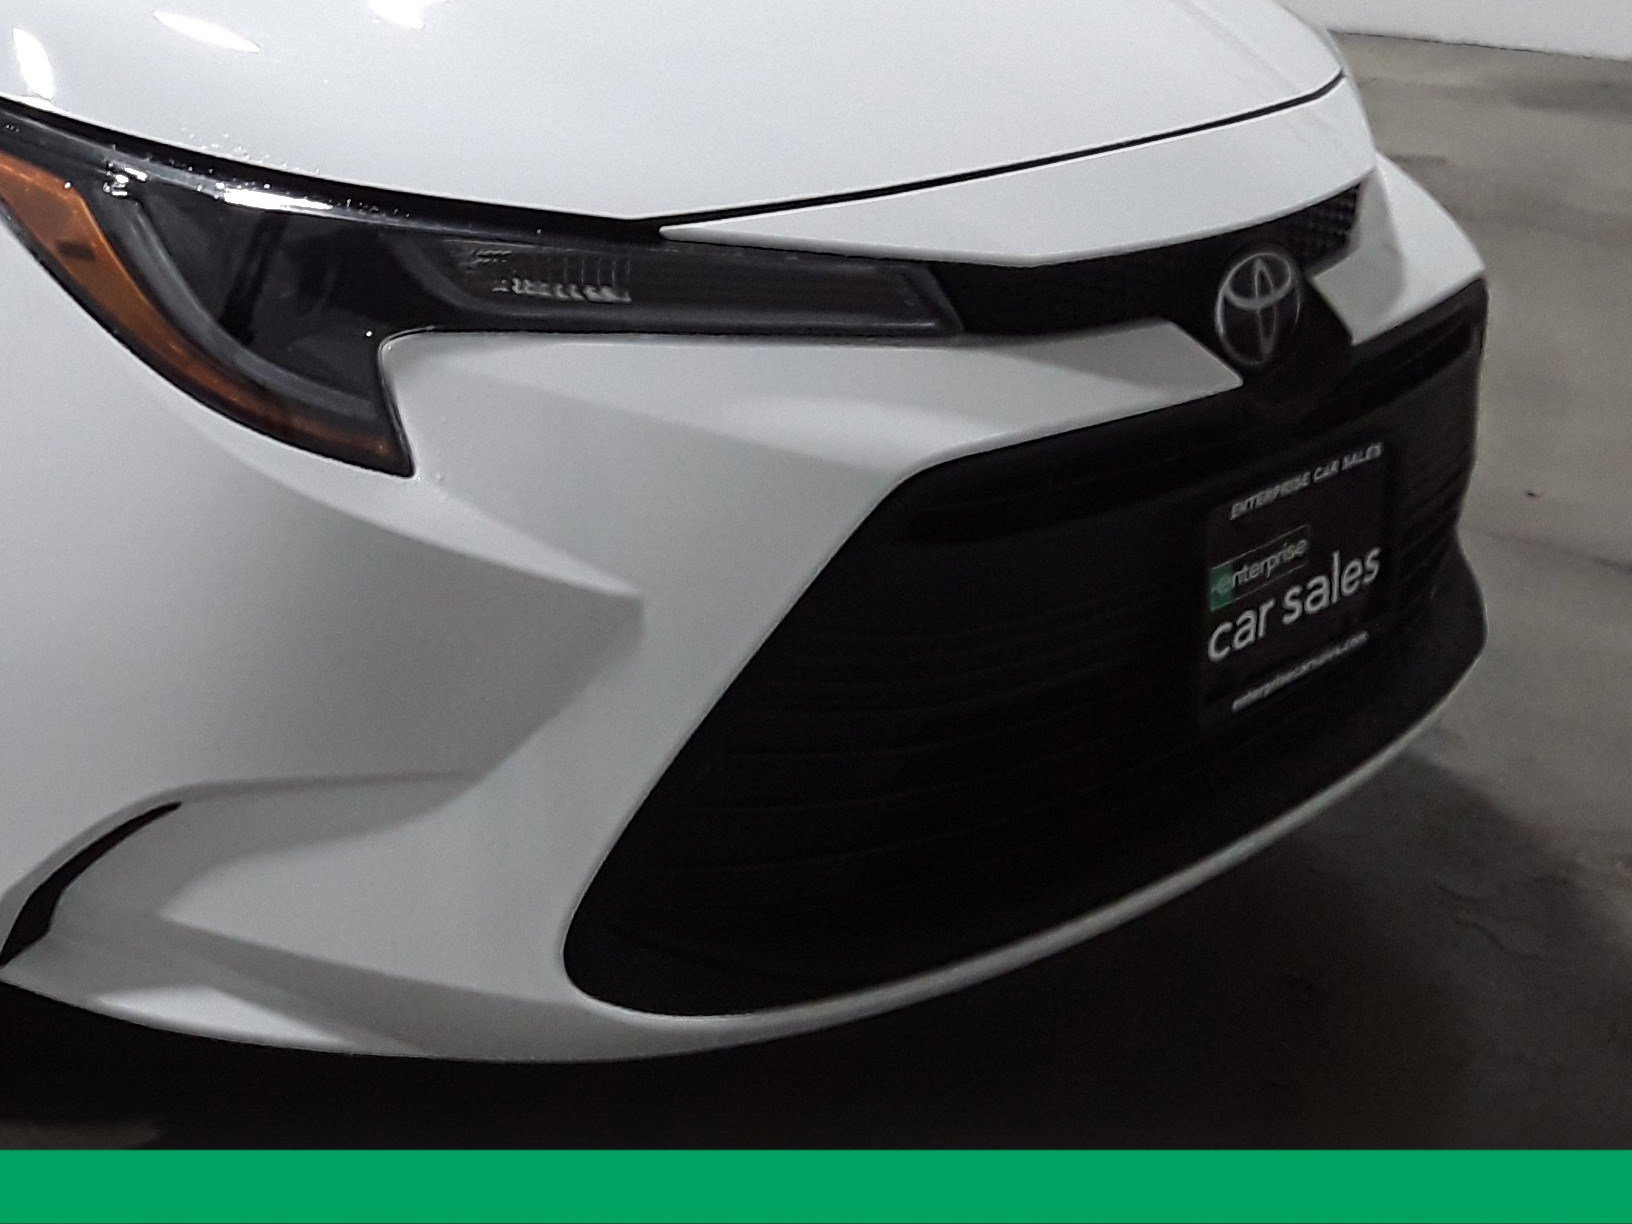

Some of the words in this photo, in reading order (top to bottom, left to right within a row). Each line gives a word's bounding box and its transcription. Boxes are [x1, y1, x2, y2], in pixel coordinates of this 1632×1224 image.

[1229, 472, 1310, 521] ENTERPRISE
[1312, 458, 1339, 481] CAR
[1207, 598, 1275, 662] car
[1282, 546, 1381, 625] sales
